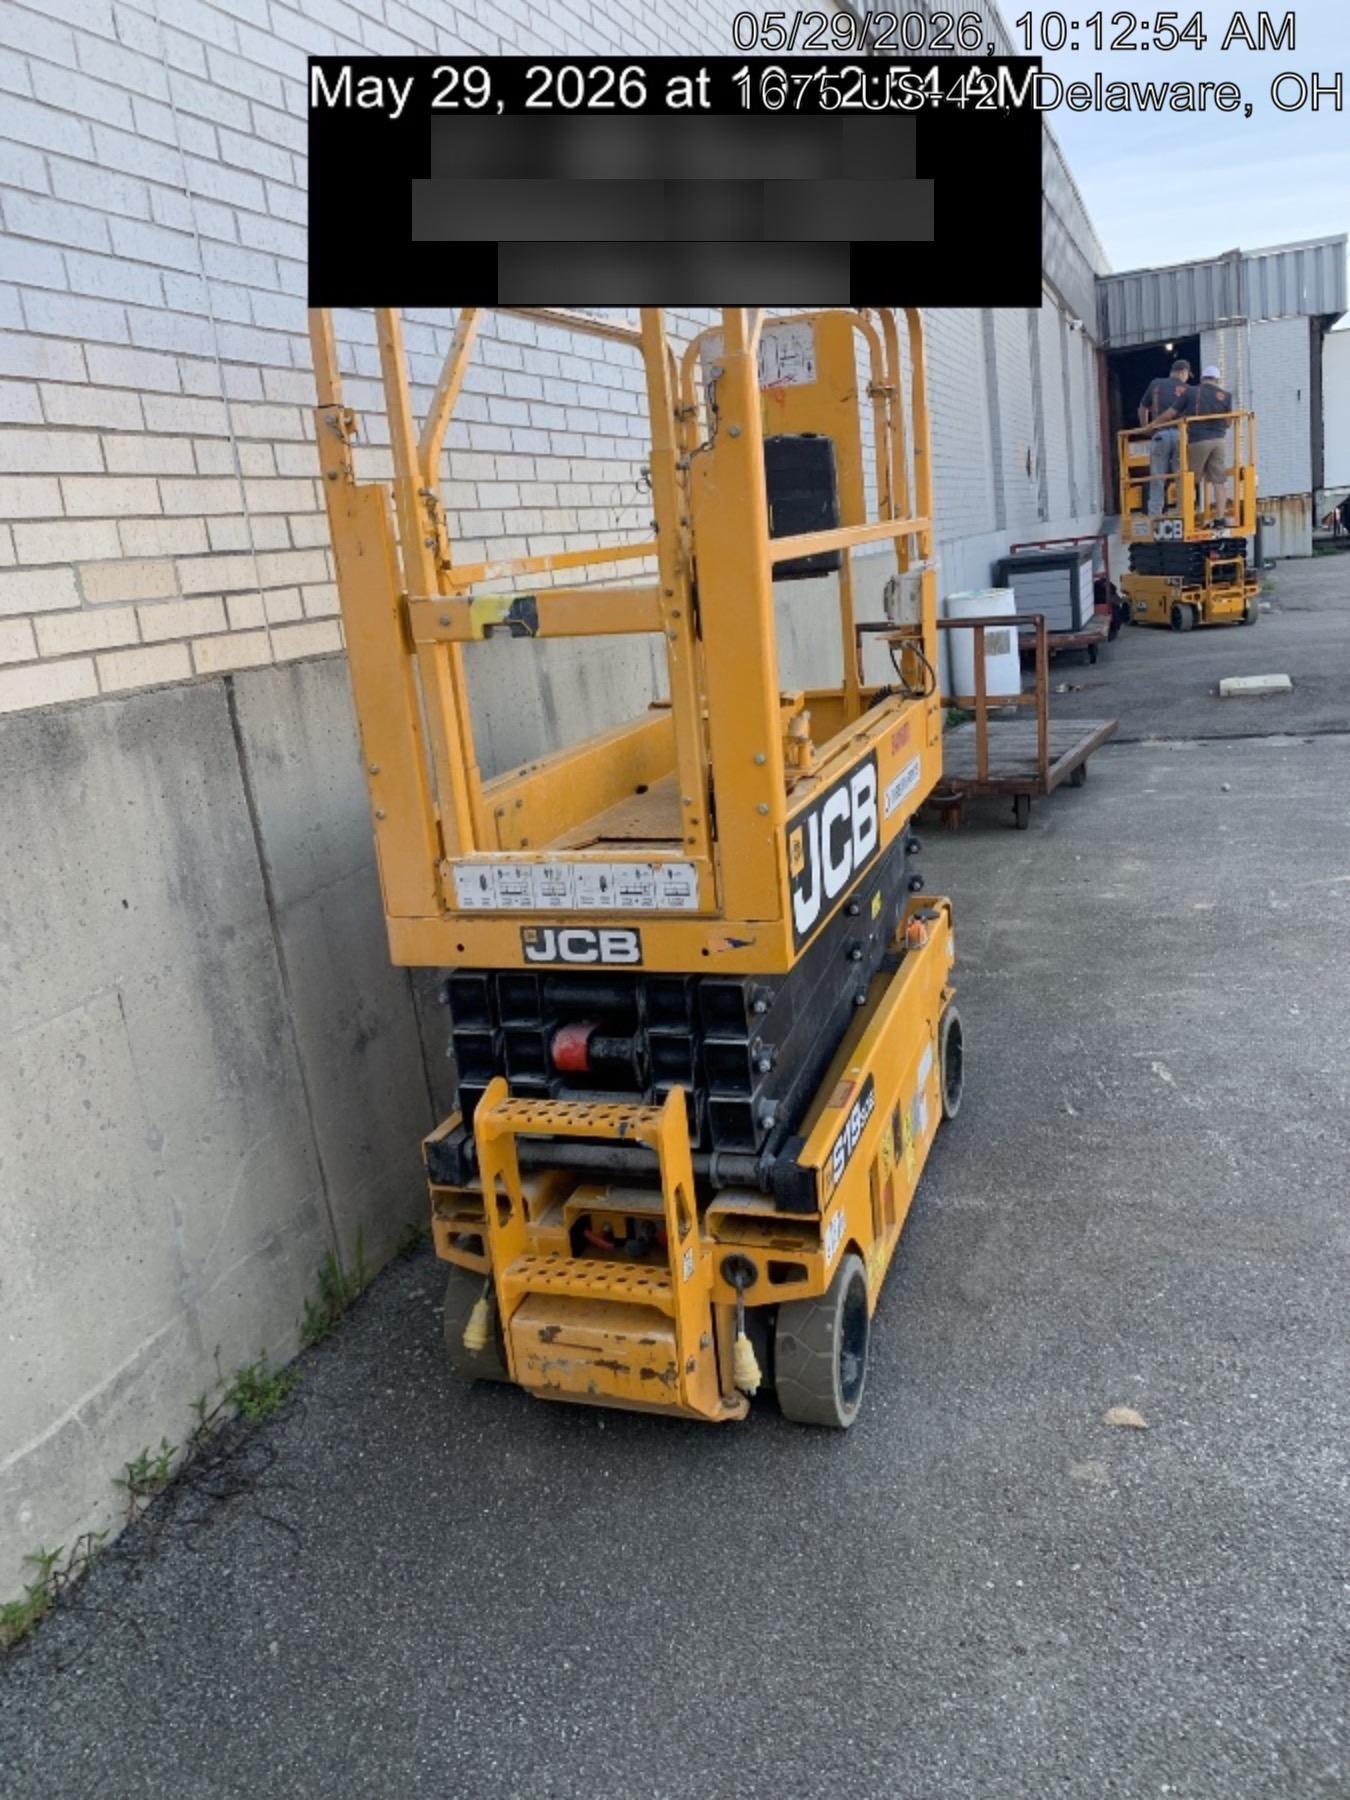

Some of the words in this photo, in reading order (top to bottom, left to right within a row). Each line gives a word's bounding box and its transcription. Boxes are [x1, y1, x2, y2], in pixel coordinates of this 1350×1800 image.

[1153, 519, 1183, 541] JCB
[793, 763, 878, 934] JCB
[525, 930, 641, 962] JCB
